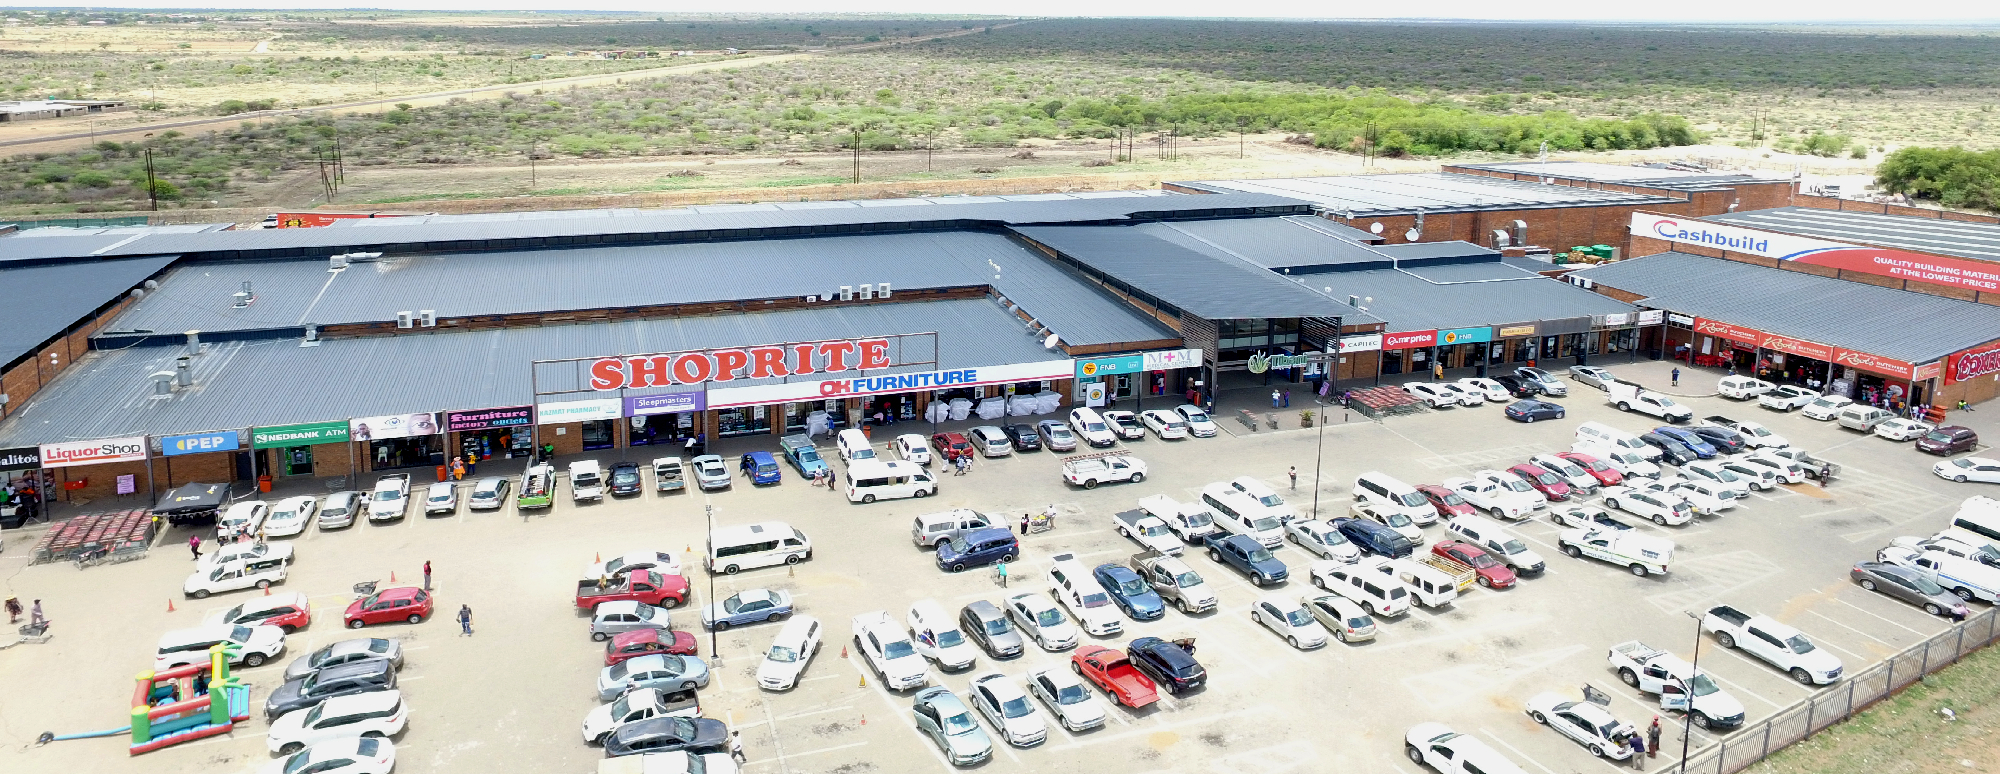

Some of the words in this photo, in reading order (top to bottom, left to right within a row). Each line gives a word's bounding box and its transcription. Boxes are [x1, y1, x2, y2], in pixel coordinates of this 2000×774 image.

[1653, 220, 1768, 252] Cashbuild
[1873, 256, 1913, 268] QUALITY
[1914, 262, 1960, 275] BUILDING
[1902, 268, 1921, 277] THE
[1922, 271, 1961, 283] LOWEST
[1962, 278, 1997, 289] PRICES
[1347, 340, 1379, 348] CAPITEC
[590, 338, 891, 391] SHOPRITE
[1100, 363, 1116, 371] FNB
[1838, 352, 1875, 366] Roots
[1876, 361, 1908, 371] BUTCHERY
[819, 379, 851, 395] OK
[853, 369, 977, 393] FURNITURE
[638, 397, 692, 407] Sleepmasters
[566, 405, 601, 414] PHARMACY
[451, 421, 488, 429] factory
[268, 430, 319, 442] NEDBANK
[325, 428, 346, 437] ATM
[186, 436, 224, 450] PEP
[0, 453, 38, 466] alito's
